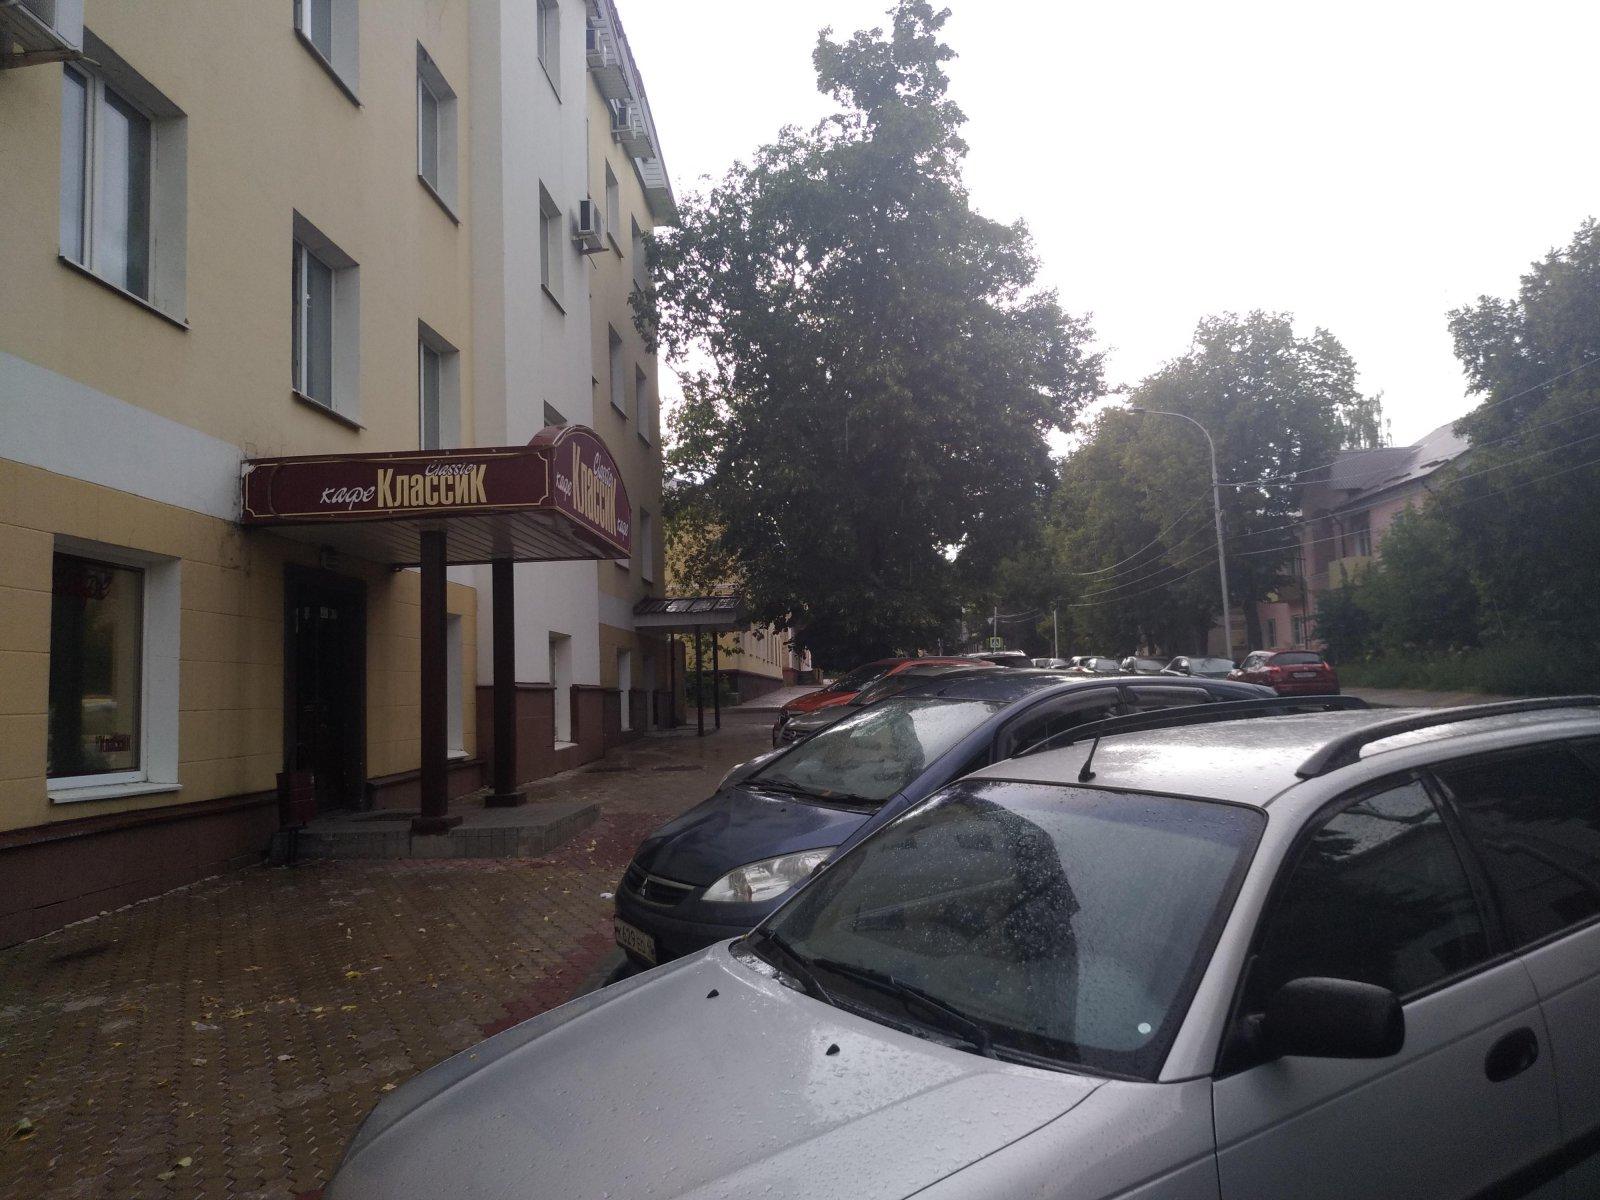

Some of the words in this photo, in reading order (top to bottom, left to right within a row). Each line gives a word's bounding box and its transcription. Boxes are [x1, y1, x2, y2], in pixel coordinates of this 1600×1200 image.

[425, 462, 476, 476] Classic
[320, 486, 375, 510] кафе
[556, 472, 573, 501] кафе
